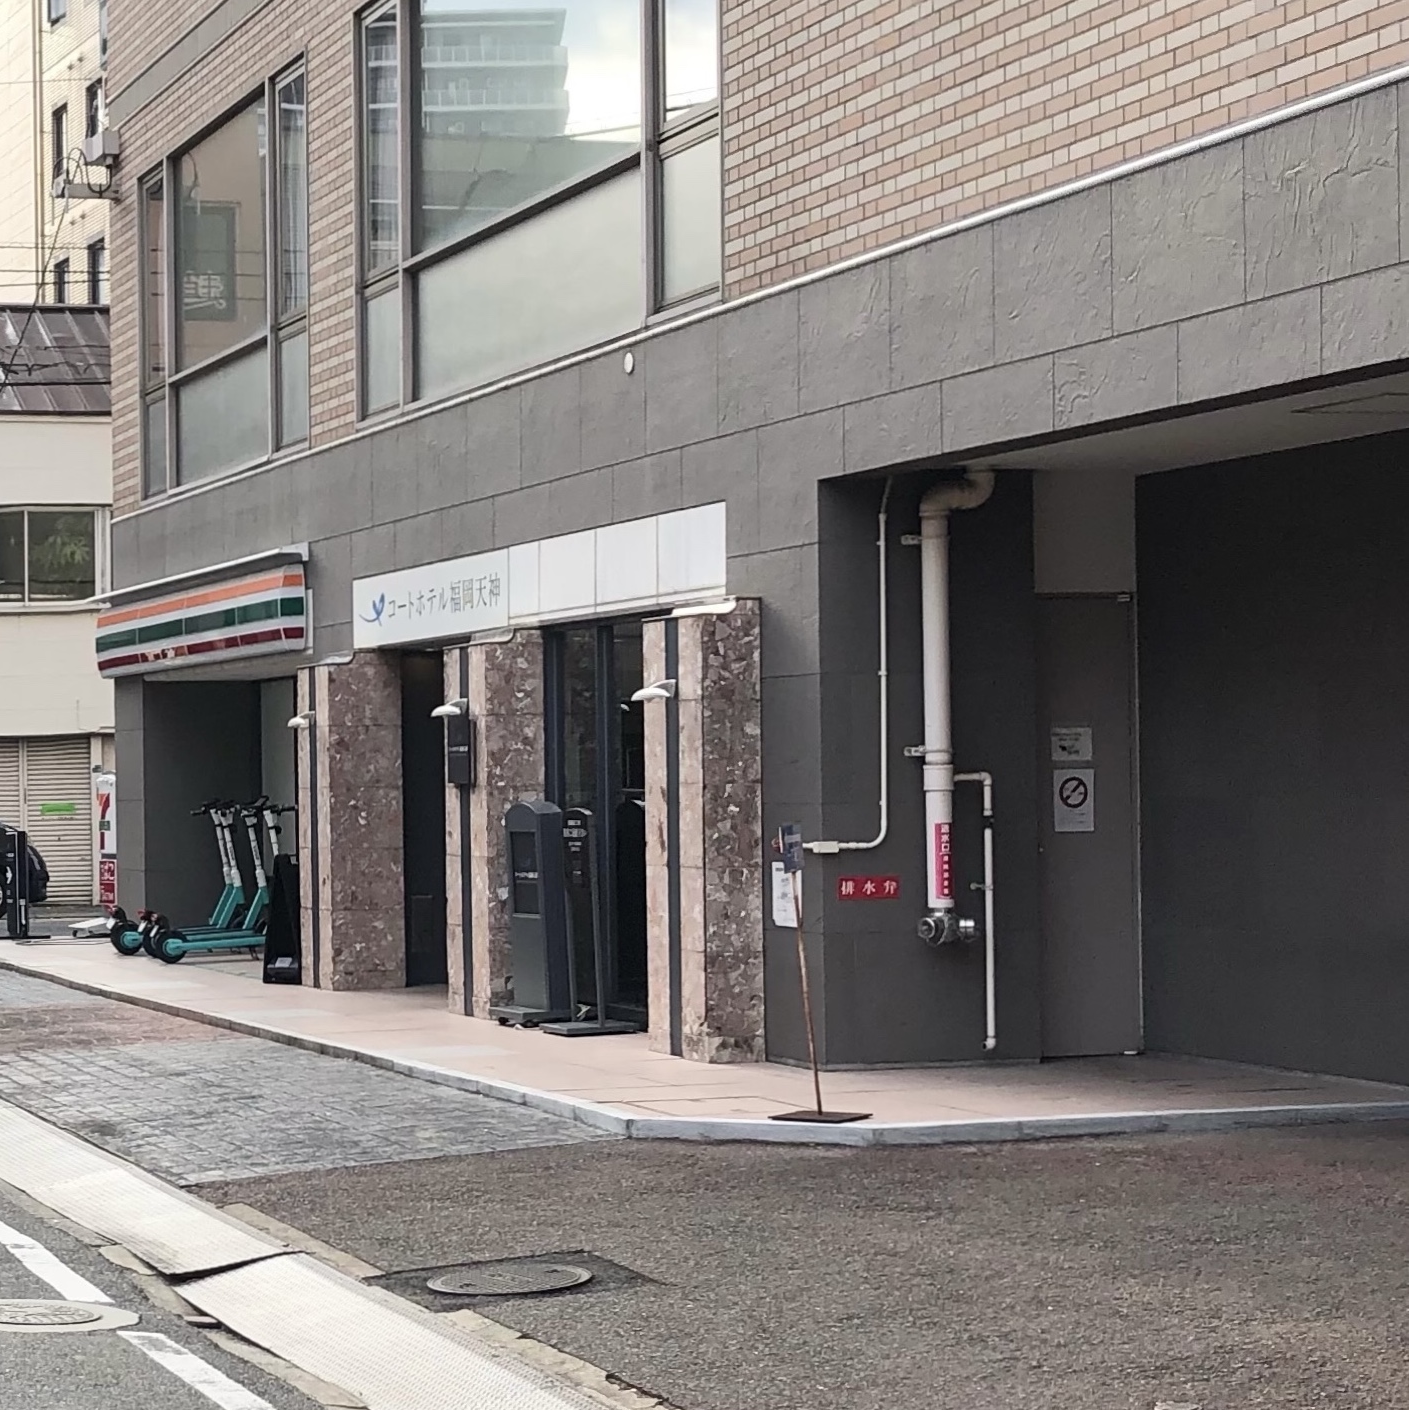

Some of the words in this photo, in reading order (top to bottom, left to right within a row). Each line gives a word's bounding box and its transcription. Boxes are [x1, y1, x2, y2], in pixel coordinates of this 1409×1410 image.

[388, 572, 501, 620] コートホテル福岡天神
[841, 880, 897, 895] 排水弁
